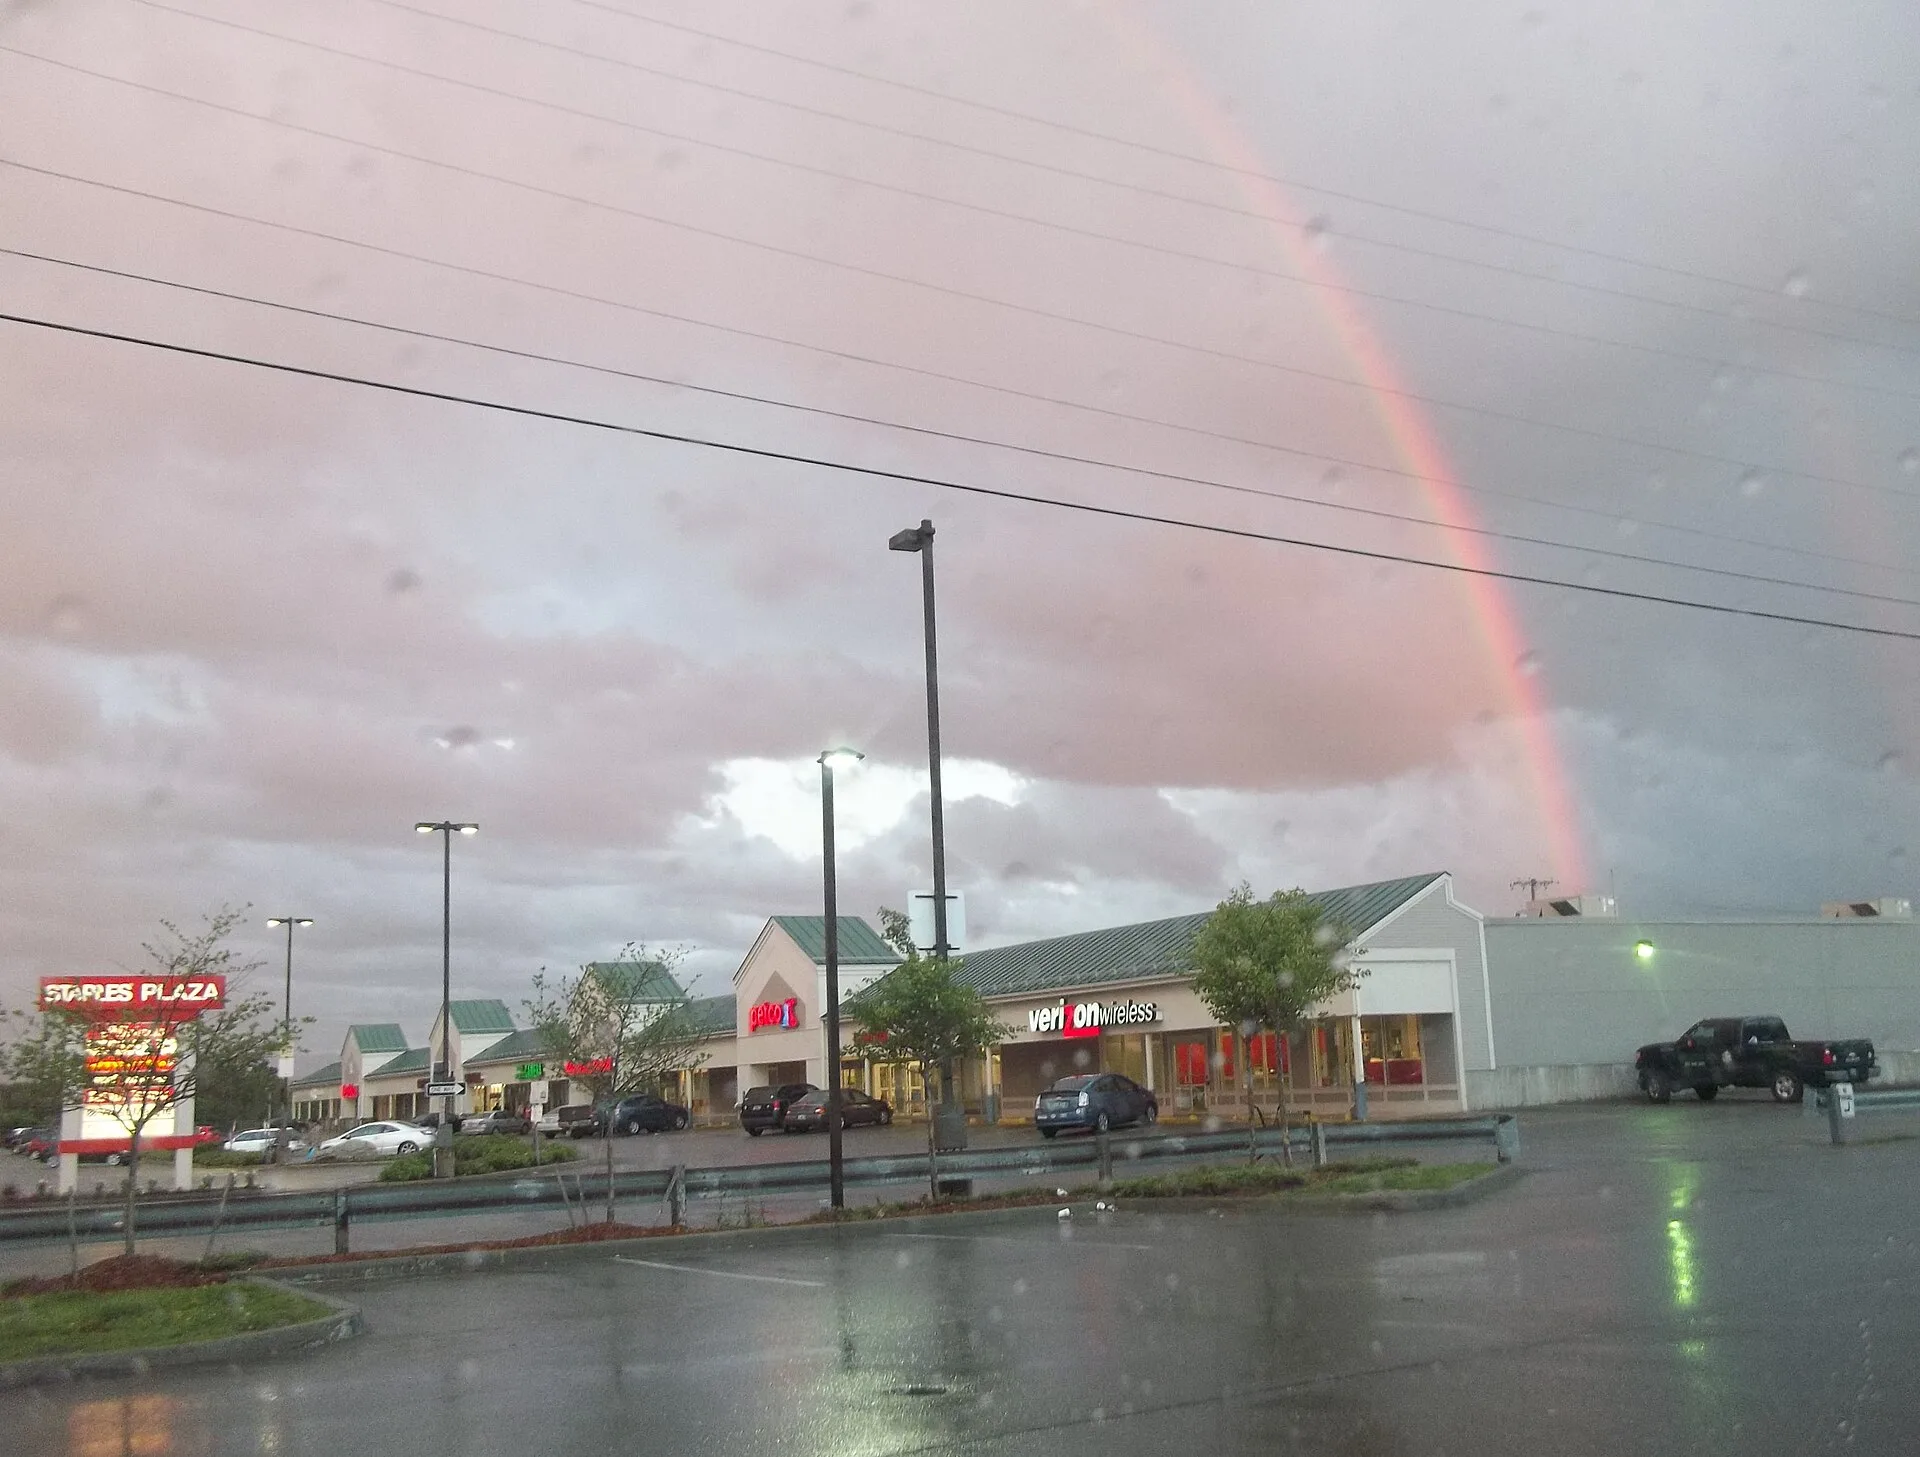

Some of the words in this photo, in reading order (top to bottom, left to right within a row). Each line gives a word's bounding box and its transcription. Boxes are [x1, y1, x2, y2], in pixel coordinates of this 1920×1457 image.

[44, 983, 133, 1002] STAPLES
[141, 983, 218, 1001] PLAZA
[1099, 1000, 1155, 1026] wireless
